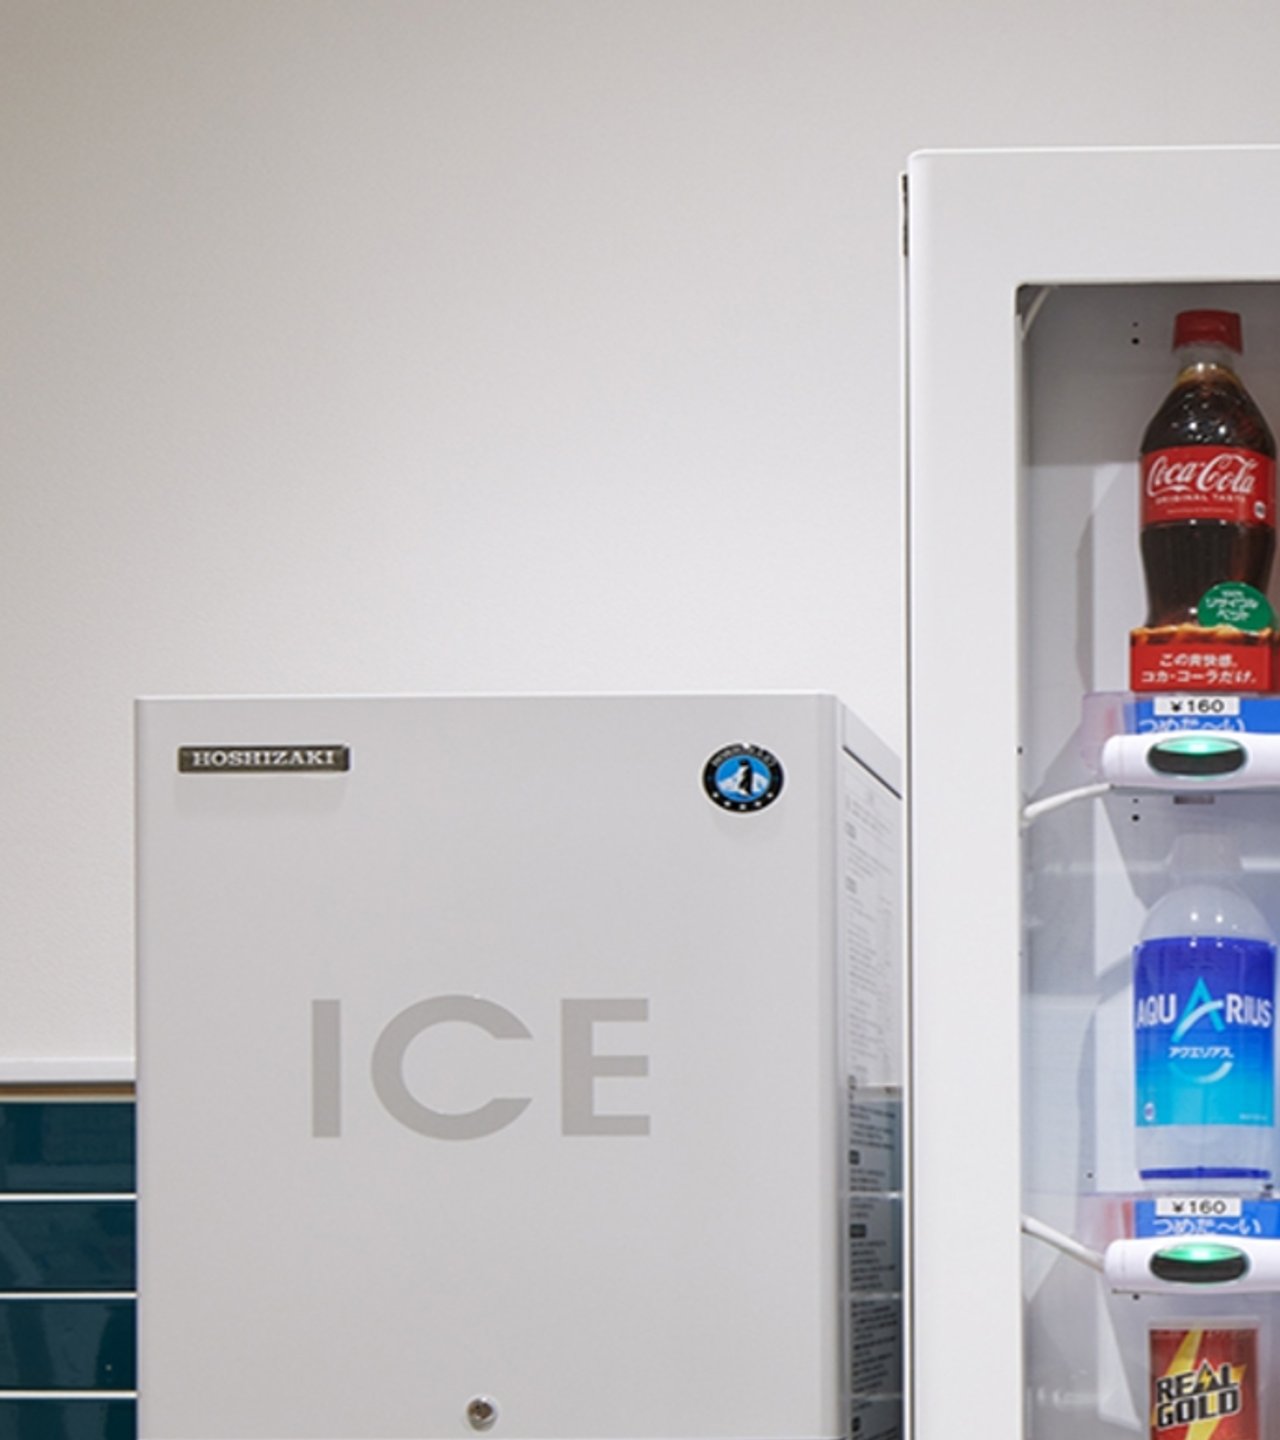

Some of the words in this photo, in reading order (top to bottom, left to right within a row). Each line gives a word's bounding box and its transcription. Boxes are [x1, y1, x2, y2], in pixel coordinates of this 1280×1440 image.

[1147, 453, 1257, 496] Coca-Cola
[1169, 699, 1225, 713] ¥160
[191, 749, 336, 767] HOSHIZAKI
[1168, 1045, 1235, 1060] アクエリアス
[311, 994, 651, 1142] ICE
[1170, 1200, 1226, 1214] ¥160
[1156, 1358, 1239, 1403] REAL
[1156, 1389, 1240, 1429] GOLD
